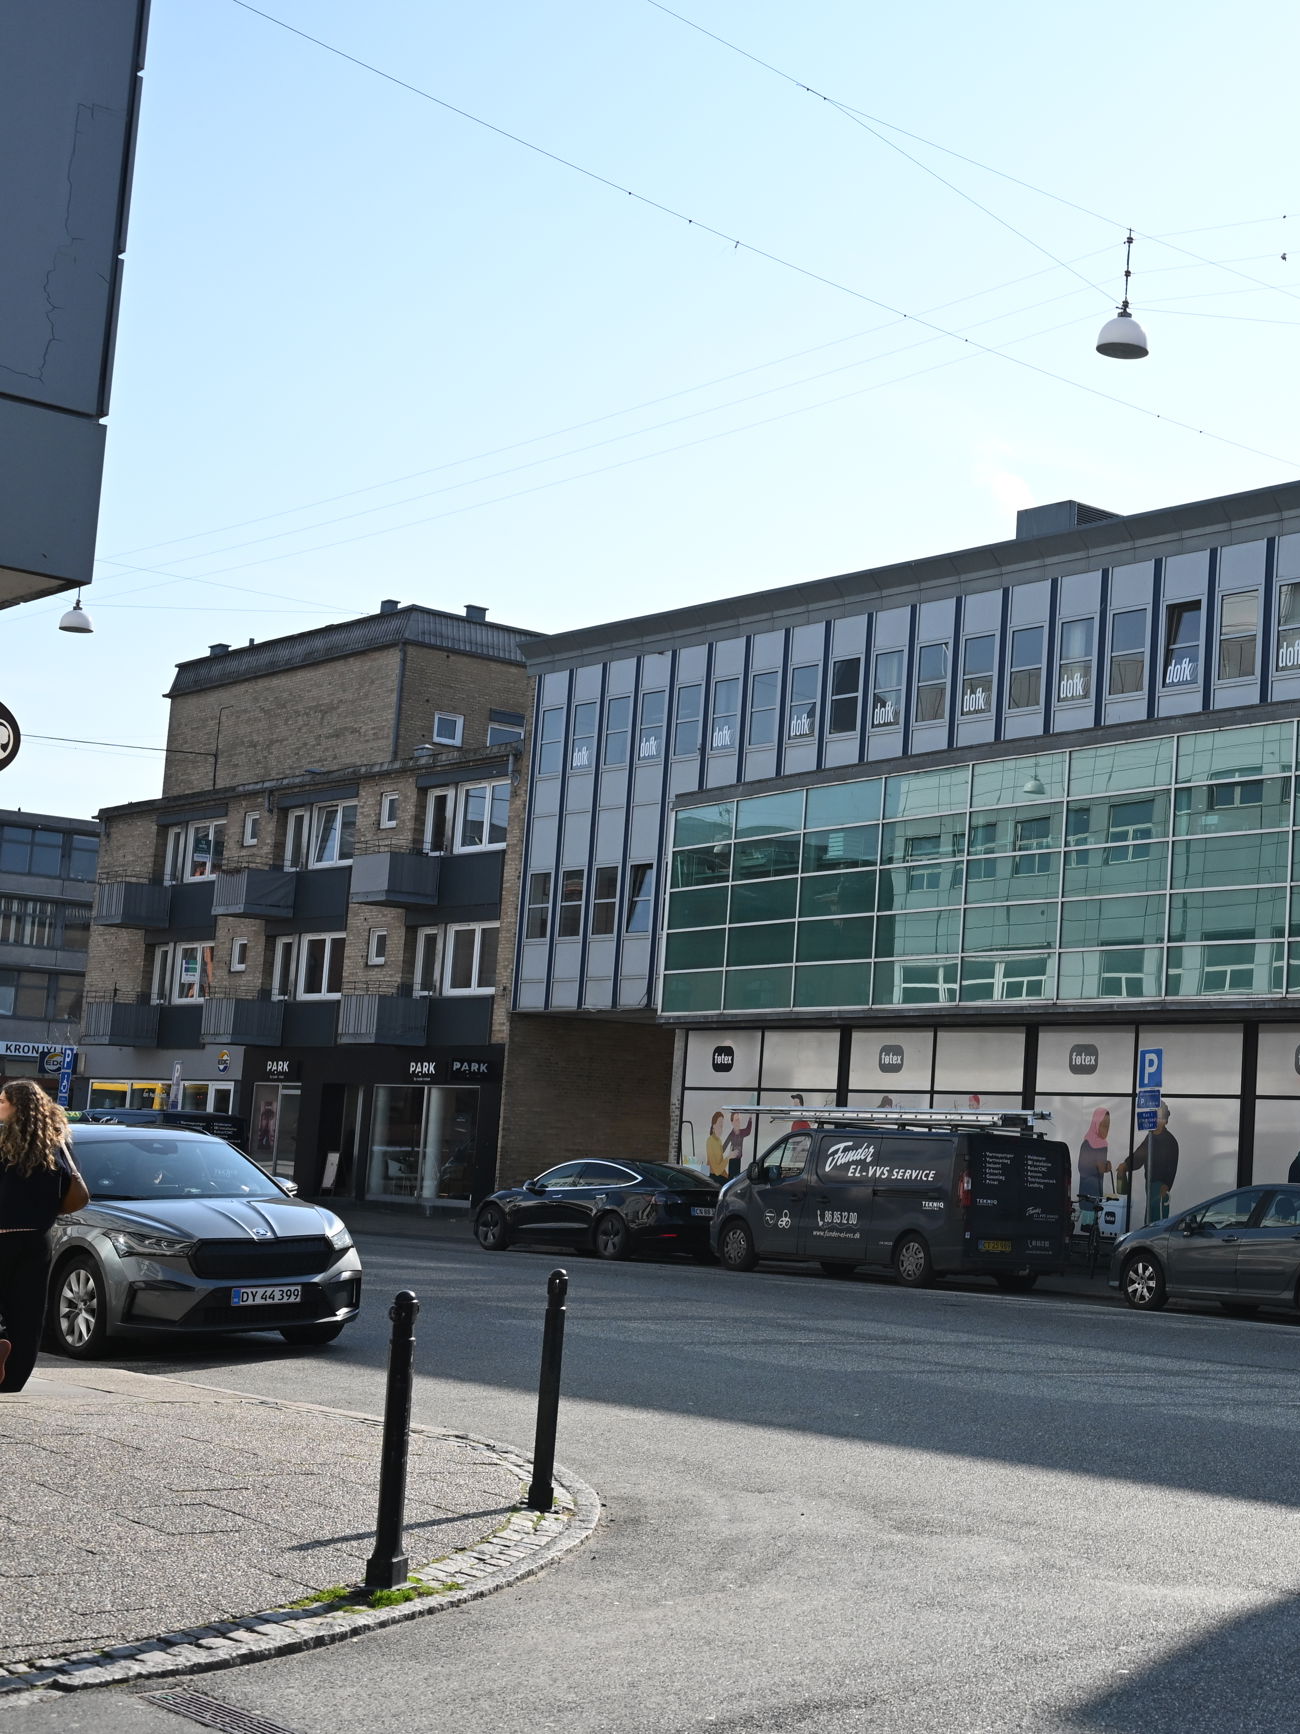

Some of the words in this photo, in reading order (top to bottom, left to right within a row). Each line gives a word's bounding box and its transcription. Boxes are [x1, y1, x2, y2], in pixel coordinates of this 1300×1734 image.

[714, 1052, 732, 1064] føtex
[881, 1052, 901, 1065] føtex
[1072, 1052, 1096, 1065] føtex
[266, 1061, 289, 1072] PARK
[409, 1062, 436, 1074] PARK
[453, 1061, 488, 1073] PARK
[1144, 1053, 1159, 1084] P
[825, 1141, 875, 1172] Funder
[847, 1165, 890, 1179] EL-VVS
[891, 1168, 936, 1181] SERVICE
[824, 1210, 833, 1223] 86
[841, 1212, 848, 1224] 12
[241, 1290, 258, 1303] DY
[261, 1289, 275, 1302] 44
[277, 1288, 300, 1301] 399
